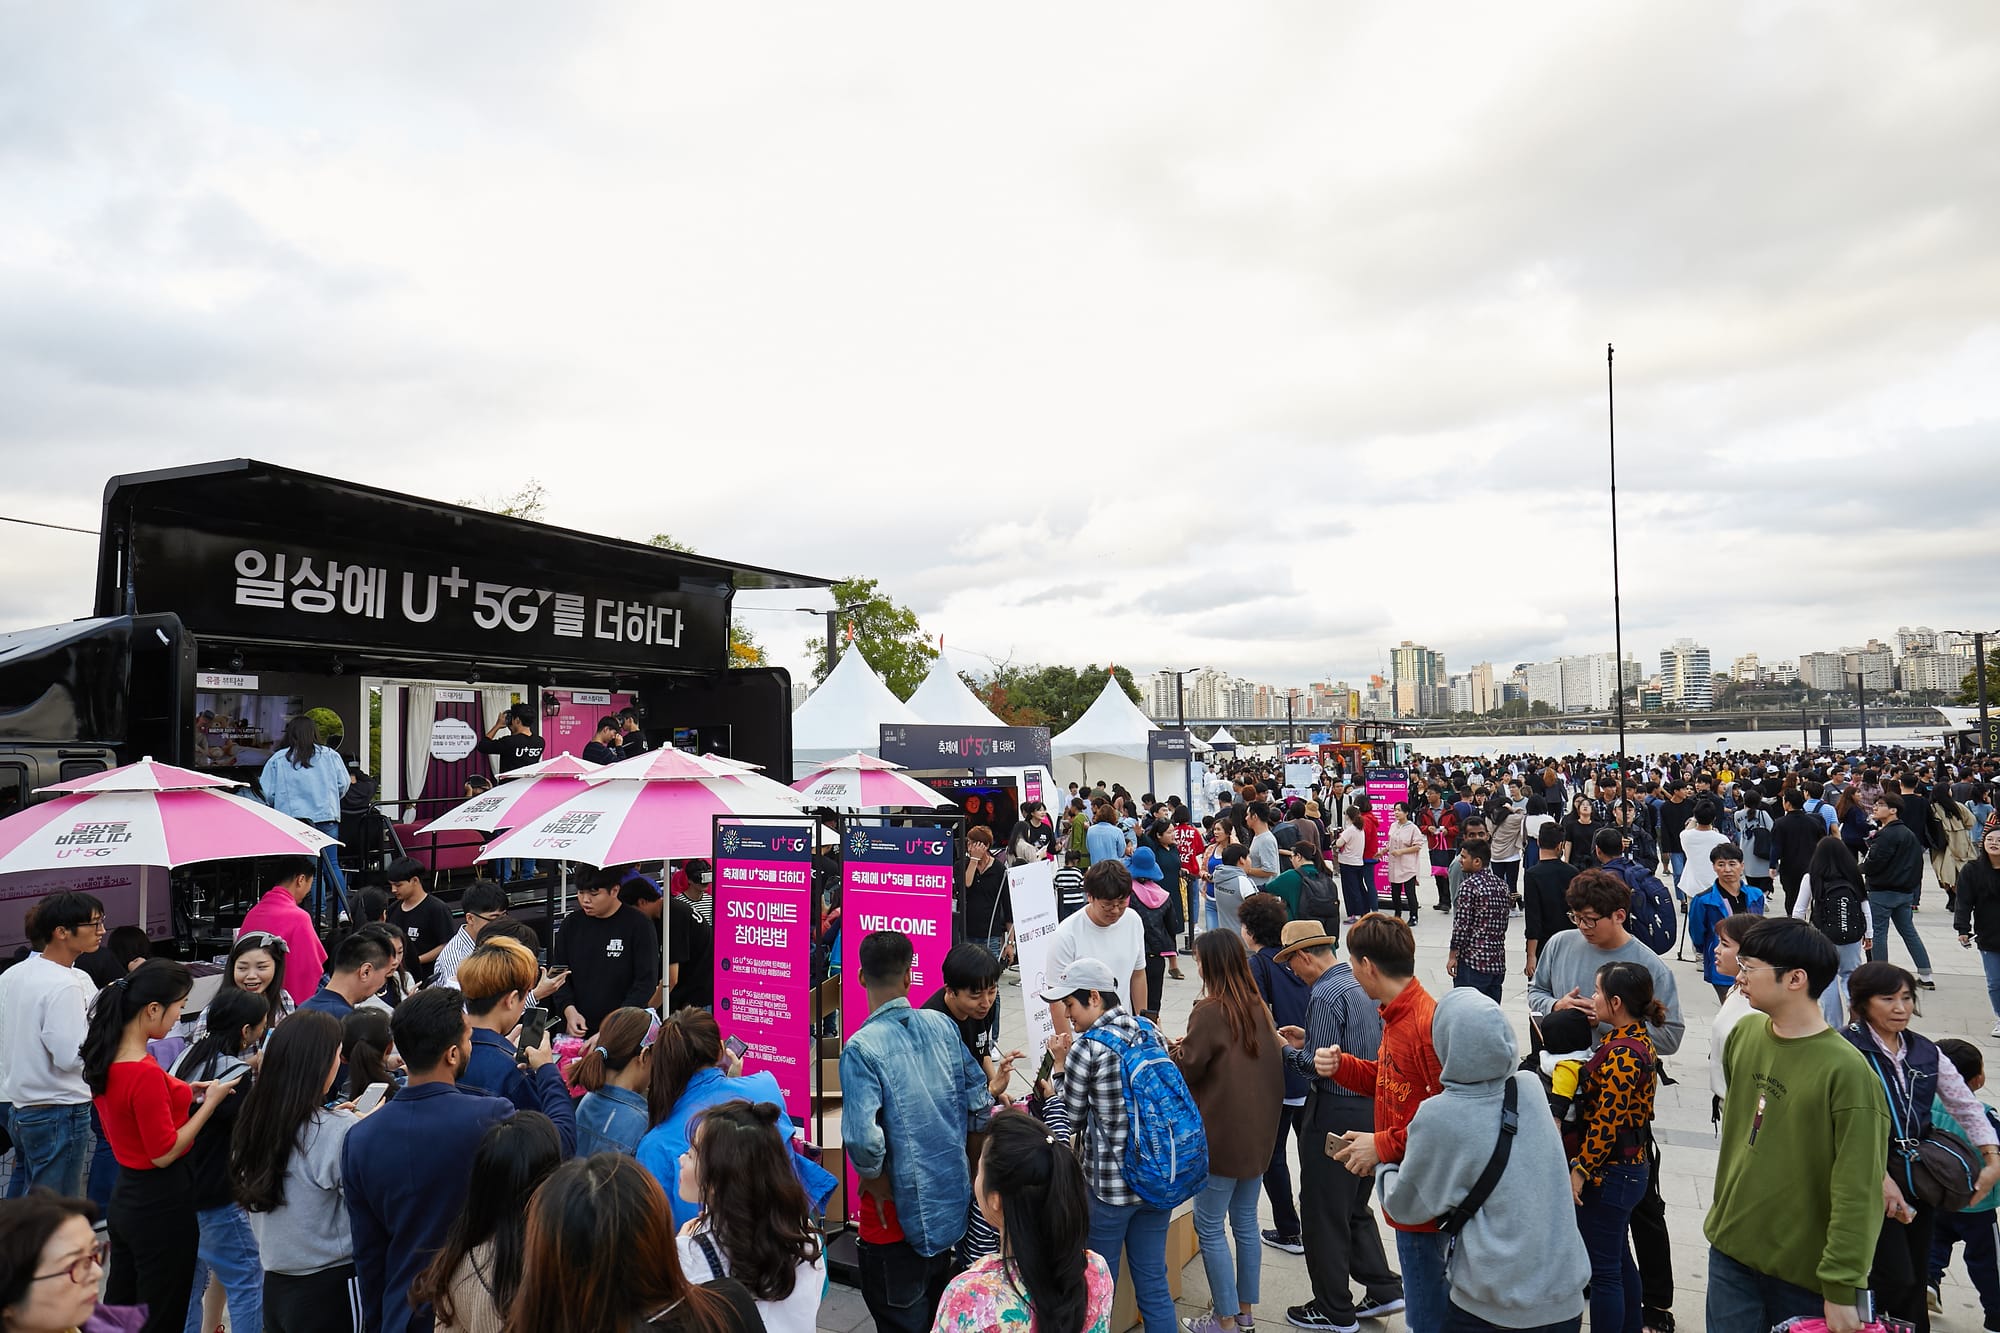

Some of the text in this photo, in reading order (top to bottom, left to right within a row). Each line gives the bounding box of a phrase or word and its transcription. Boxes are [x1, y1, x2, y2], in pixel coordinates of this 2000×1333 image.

[234, 549, 388, 620] 일상에
[594, 598, 685, 649] 더하다
[1990, 724, 1998, 753] COF
[516, 746, 542, 757] U+5G
[938, 740, 958, 754] 축제에
[1000, 740, 1016, 753] 더하다
[558, 812, 602, 824] 일상을
[71, 822, 128, 834] 일상을
[540, 823, 598, 834] 바꿉니다
[1174, 829, 1195, 838] EACE
[55, 832, 132, 846] 바꿉니다
[532, 836, 577, 848] U+5G
[772, 835, 807, 852] U+5G
[905, 838, 947, 855] U+5G
[56, 848, 118, 858] U+5G
[723, 868, 748, 880] 축제에
[778, 870, 806, 884] 더하다
[852, 870, 878, 884] 축제에
[915, 874, 947, 888] 더하다
[727, 900, 755, 919] SNS
[756, 902, 798, 923] 이벤트
[860, 914, 936, 936] WELCOME
[735, 924, 788, 948] 참여방법
[1767, 1076, 1787, 1095] NEVER
